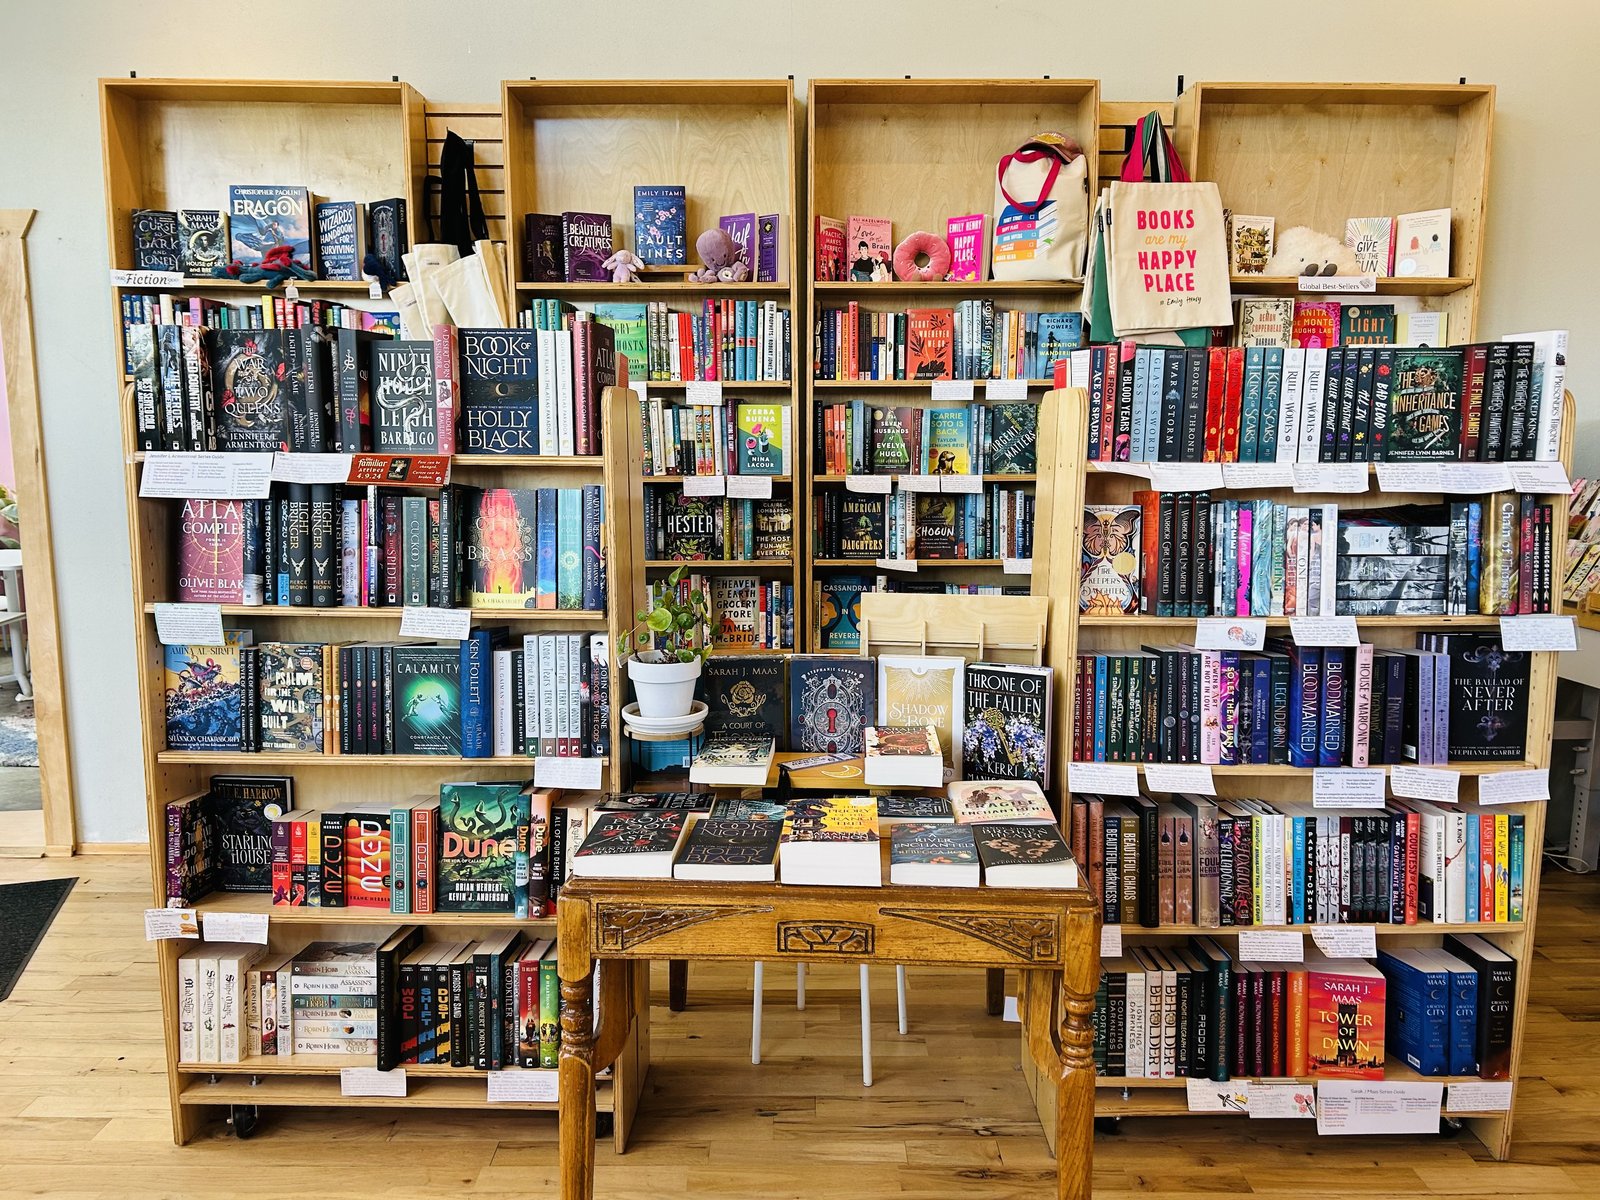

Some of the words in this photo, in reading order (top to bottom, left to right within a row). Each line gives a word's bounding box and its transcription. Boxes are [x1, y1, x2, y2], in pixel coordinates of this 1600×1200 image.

[234, 197, 304, 219] ERAGON
[139, 220, 176, 235] CURSE
[949, 223, 964, 233] EMILY
[965, 220, 982, 231] HENRY
[1137, 210, 1195, 230] BOOKS
[320, 224, 353, 244] HANDBOOK
[569, 223, 611, 236] BEAUTIFUL
[853, 226, 875, 241] Love
[135, 237, 179, 250] DARK
[569, 235, 611, 254] CREATURES
[638, 235, 683, 245] FAULT
[954, 235, 975, 250] HAPPY
[1145, 235, 1166, 245] are
[1168, 234, 1188, 250] my
[1357, 241, 1378, 252] GIVE
[321, 245, 354, 255] SURVIVING
[638, 249, 683, 259] LINES
[954, 249, 974, 262] PLACE
[141, 252, 180, 270] LONELY
[1138, 250, 1197, 270] HAPPY
[126, 273, 168, 286] Fiction
[1144, 273, 1195, 292] PLACE
[1301, 309, 1327, 317] ANITA
[1304, 318, 1333, 326] MONTE
[1350, 318, 1385, 332] LIGHT
[465, 336, 522, 356] BOOK
[521, 342, 531, 350] OF
[234, 358, 267, 370] WAR
[379, 352, 431, 372] NINTH
[462, 354, 531, 380] NIGHT
[1171, 361, 1179, 386] WAR
[1191, 360, 1200, 399] BROKEN
[1398, 372, 1414, 387] THE
[234, 387, 268, 399] TWO
[380, 376, 432, 396] HOUSE
[1122, 376, 1133, 408] BLOOD
[224, 402, 281, 415] QUEENS
[1393, 393, 1456, 414] INHERITANCE
[380, 408, 433, 427] LEIGH
[468, 410, 531, 428] HOLLY
[1119, 408, 1131, 432] YEARS
[1166, 404, 1175, 444] STORM
[1418, 416, 1449, 432] GAMES
[230, 432, 269, 441] JENNIFER
[380, 430, 434, 445] BARDUGO
[991, 426, 1019, 451] URGENT
[1187, 413, 1197, 453] THRONE
[225, 441, 283, 449] ARMENTROUT
[468, 429, 533, 453] BLACK
[1005, 430, 1036, 460] MATTERS
[880, 450, 903, 458] HUGO
[843, 502, 881, 513] AMERICAN
[475, 517, 526, 531] CITY
[667, 515, 713, 533] HESTER
[1502, 503, 1514, 537] Chain
[915, 525, 955, 537] SHOGUN
[842, 539, 883, 550] DAUGHTERS
[468, 546, 533, 562] BRASS
[180, 578, 214, 588] OLIVIE
[722, 580, 756, 588] HEAVEN
[727, 590, 756, 598] EARTH
[716, 600, 757, 609] GROCERY
[723, 610, 751, 618] STORE
[722, 624, 753, 633] JAMES
[715, 633, 759, 643] McBRIDE
[469, 639, 479, 659] KEN
[398, 663, 460, 674] CALAMITY
[708, 667, 739, 675] SARAH
[752, 667, 778, 675] MAAS
[275, 672, 313, 686] PSALM
[469, 662, 481, 704] FOLLETT
[968, 673, 1016, 690] THRONE
[1020, 678, 1042, 694] OF
[1360, 663, 1369, 690] HOUSE
[1462, 686, 1515, 699] NEVER
[270, 700, 305, 713] WILD
[889, 702, 949, 719] SHADOW
[968, 691, 990, 709] THE
[995, 694, 1042, 715] FALLEN
[1301, 663, 1318, 752] BLOODMARKED
[1325, 662, 1342, 751] BLOODMARKED
[1462, 699, 1514, 711] AFTER
[262, 715, 288, 729] BUILT
[1273, 682, 1287, 748] LEGENDBORN
[729, 722, 753, 730] COURT
[987, 762, 1019, 776] KERRI
[442, 832, 516, 858] Dune
[518, 826, 528, 852] Dune
[535, 825, 545, 852] Dune
[231, 849, 271, 864] HOUSE
[360, 820, 382, 892] DUNE
[324, 835, 342, 894] DUNE
[455, 883, 474, 892] BRIAN
[476, 883, 502, 892] HERBERT
[449, 893, 466, 901] KEVIN
[477, 893, 508, 902] ANDERSON
[1324, 982, 1360, 992] SARAH
[402, 988, 414, 1019] WOOL
[421, 988, 431, 1025] SHIFT
[438, 988, 448, 1019] DUST
[1332, 994, 1362, 1004] MAAS
[1319, 1011, 1372, 1027] TOWER
[1198, 1014, 1206, 1062] PRODIGY
[1322, 1038, 1370, 1051] DAWN
